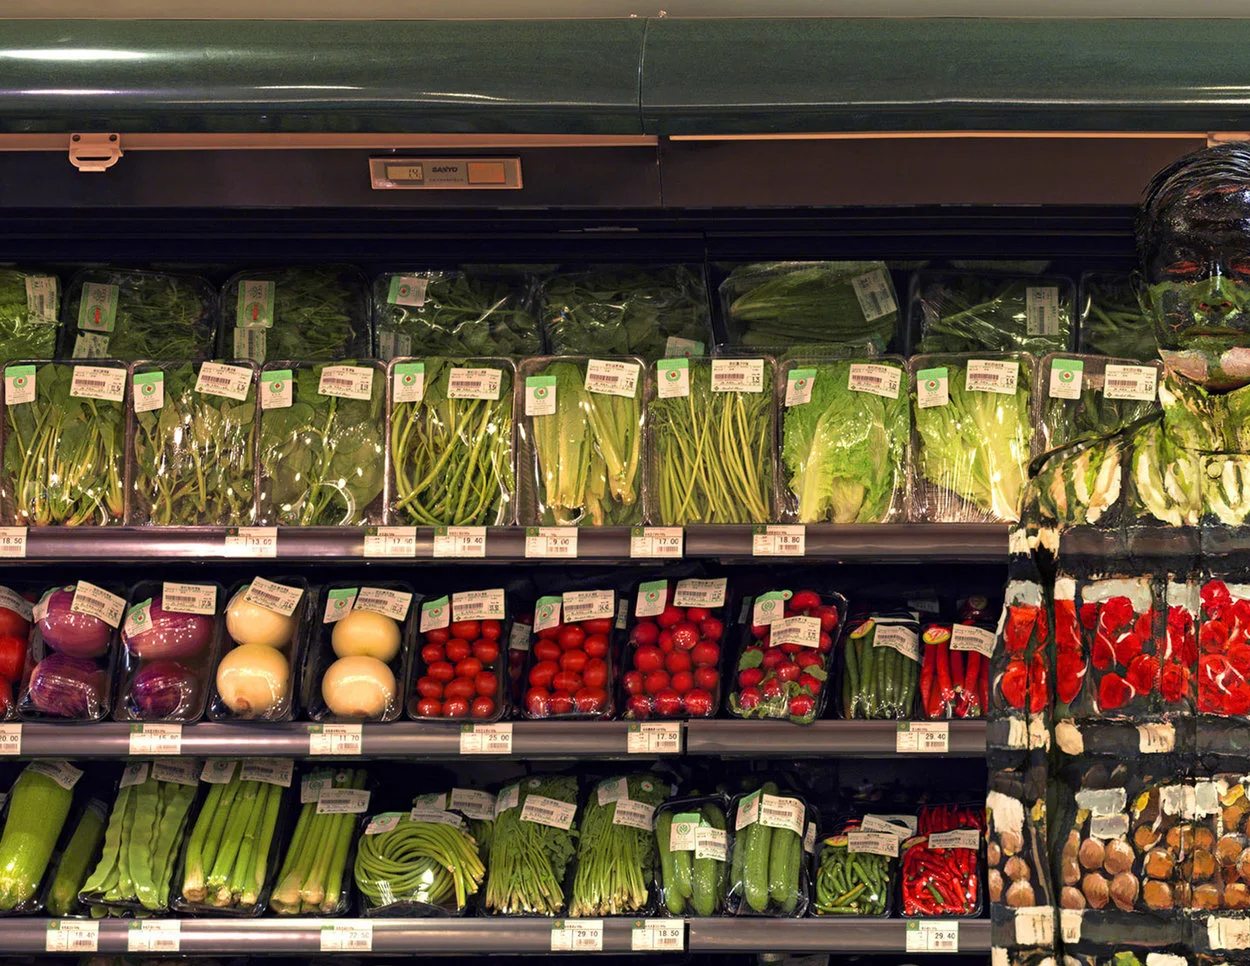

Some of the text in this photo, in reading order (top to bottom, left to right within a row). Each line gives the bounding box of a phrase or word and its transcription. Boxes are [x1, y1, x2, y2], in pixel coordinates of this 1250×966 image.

[2, 537, 23, 545] 18.50
[462, 537, 483, 545] 19.40
[658, 538, 679, 546] 17.00
[780, 536, 801, 544] 18.80
[488, 734, 510, 742] 25.00
[657, 732, 678, 740] 17.50
[925, 733, 946, 741] 29.40
[577, 930, 598, 938] 29.10
[935, 932, 956, 940] 29.40
